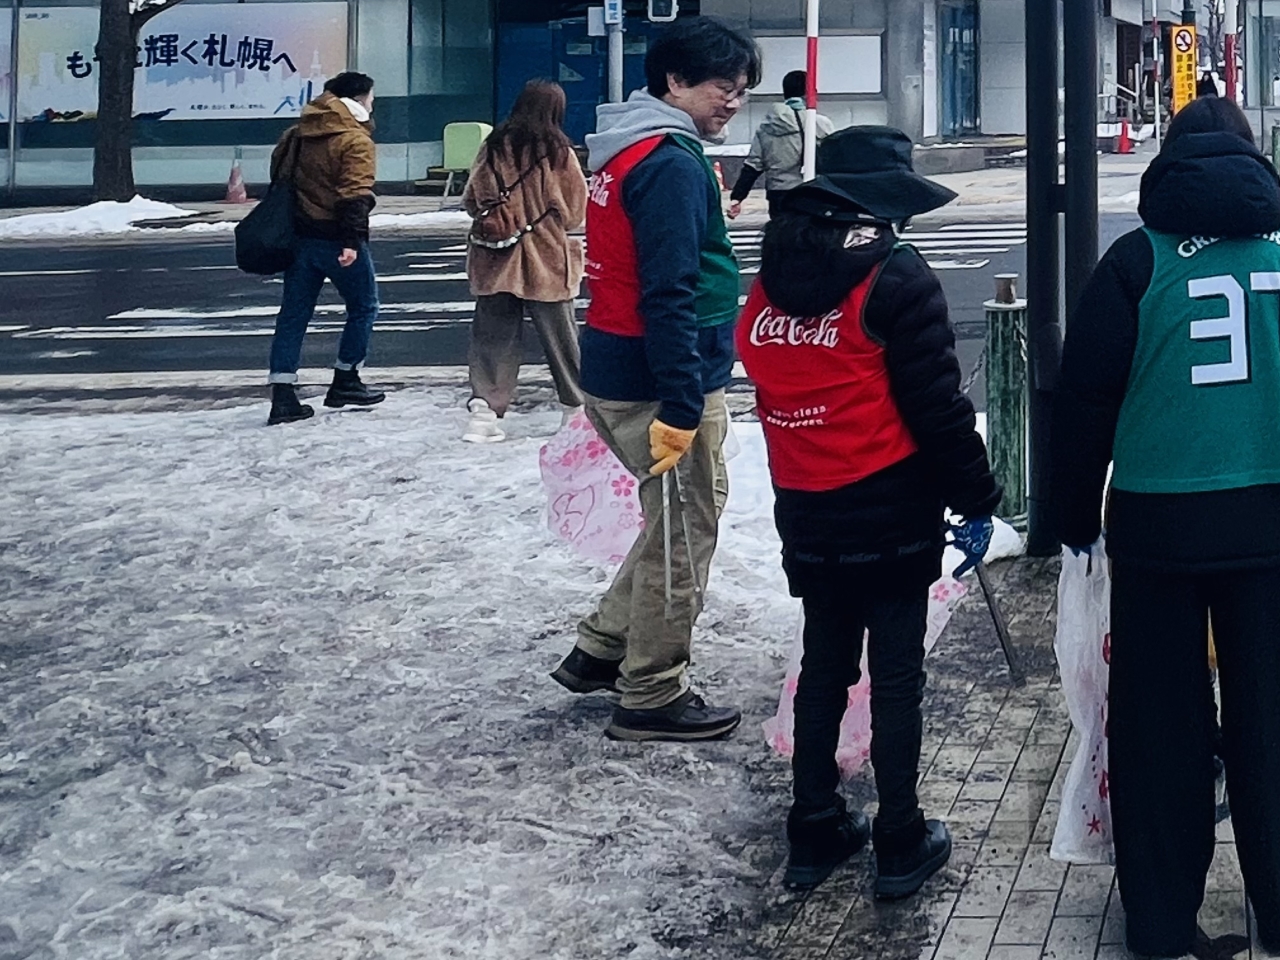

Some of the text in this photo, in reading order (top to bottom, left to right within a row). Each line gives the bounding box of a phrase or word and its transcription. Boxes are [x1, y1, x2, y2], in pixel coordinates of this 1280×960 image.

[66, 33, 298, 79] も輝く札幌へ
